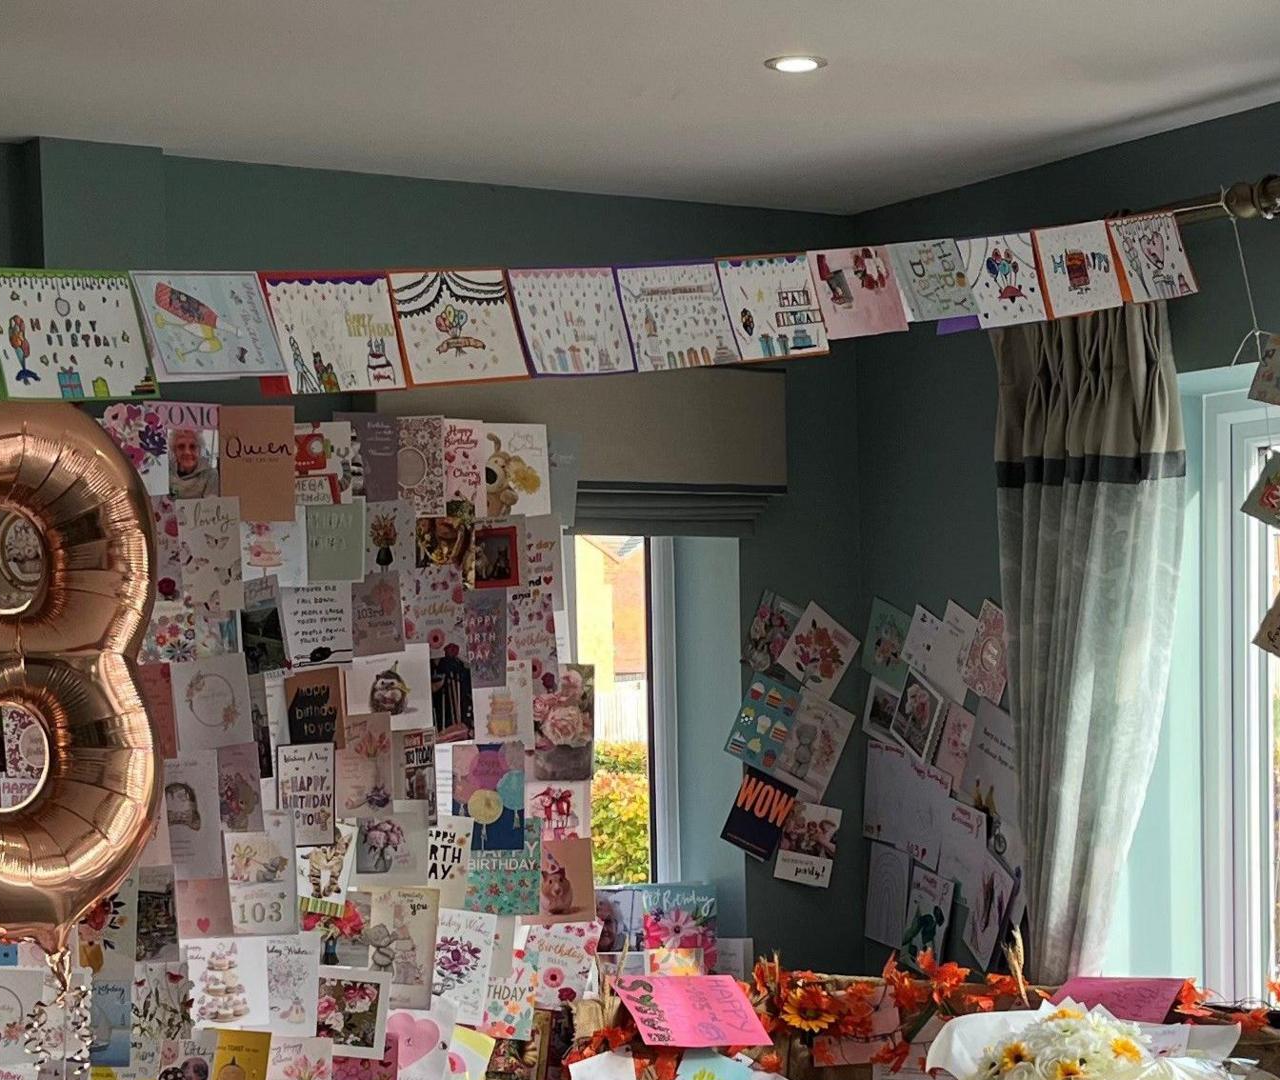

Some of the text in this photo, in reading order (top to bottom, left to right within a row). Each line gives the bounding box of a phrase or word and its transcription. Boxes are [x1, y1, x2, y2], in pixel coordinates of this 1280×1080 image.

[447, 424, 474, 440] Happy
[225, 436, 293, 459] Queen
[281, 792, 332, 809] BIRTHDAY
[736, 773, 796, 828] WOW
[428, 829, 457, 844] appy
[468, 857, 537, 872] BIRTHDAY
[238, 900, 283, 924] 103
[409, 902, 428, 916] you
[537, 938, 585, 960] Birthday
